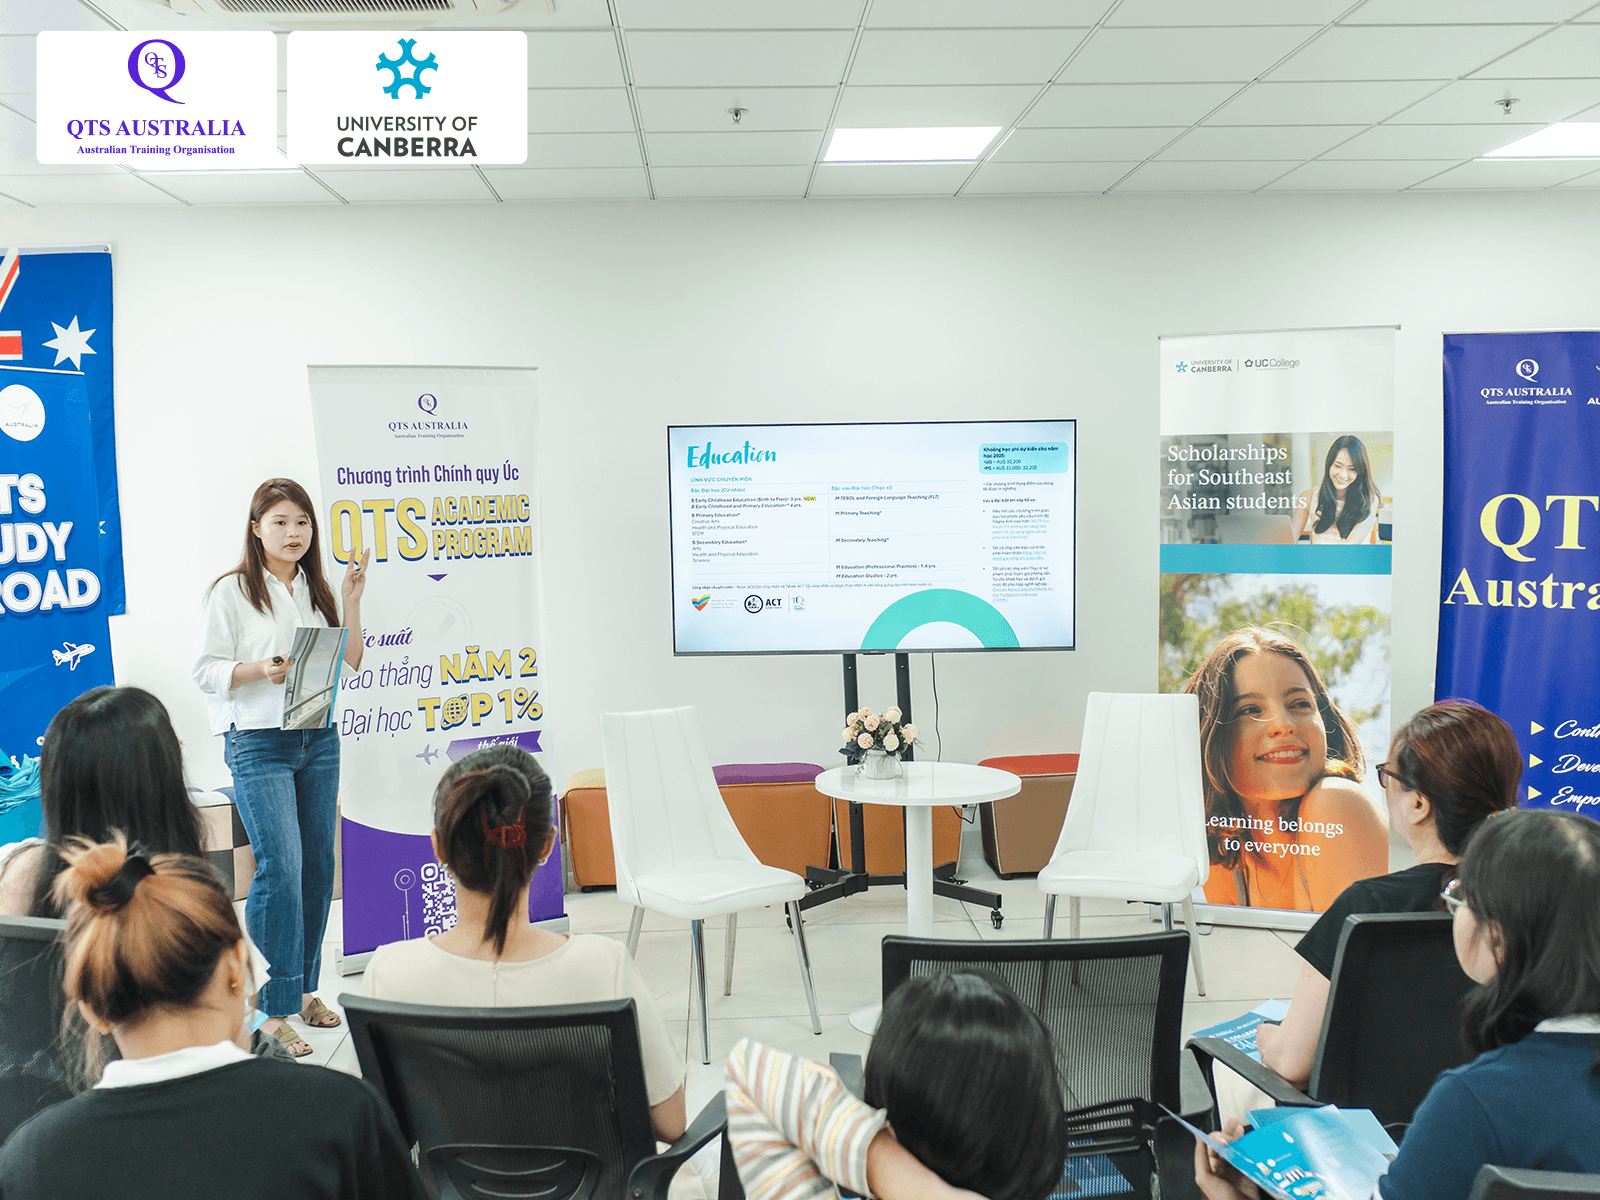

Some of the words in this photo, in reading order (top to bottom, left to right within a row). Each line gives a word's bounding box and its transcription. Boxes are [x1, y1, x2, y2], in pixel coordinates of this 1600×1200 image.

[1255, 359, 1268, 367] UC
[1269, 358, 1300, 369] College
[1481, 388, 1503, 398] QTS
[1505, 387, 1572, 396] AUSTRALIA
[388, 422, 408, 432] QTS
[411, 422, 468, 430] AUSTRALIA
[687, 440, 777, 469] Education
[1167, 444, 1288, 465] Scholarships
[337, 467, 392, 487] Chương
[396, 465, 430, 483] trình
[434, 464, 472, 483] Chính
[476, 467, 499, 484] quy
[503, 460, 519, 481] Úc
[1167, 469, 1194, 486] for
[1199, 469, 1292, 485] Southeast
[431, 494, 530, 526] ACADEMIC
[1167, 493, 1221, 510] Asian
[1226, 493, 1308, 510] students
[330, 497, 428, 565] QTS
[1480, 493, 1599, 562] QT
[432, 526, 532, 561] PROGRAM
[378, 627, 413, 646] suất
[380, 656, 433, 689] thẳng
[440, 645, 512, 686] NĂM
[519, 647, 538, 678] 2
[342, 708, 372, 741] Đại
[376, 706, 412, 738] học
[497, 687, 543, 724] 1%
[1278, 816, 1344, 838] belongs
[1224, 837, 1240, 851] to
[1244, 841, 1321, 858] everyone
